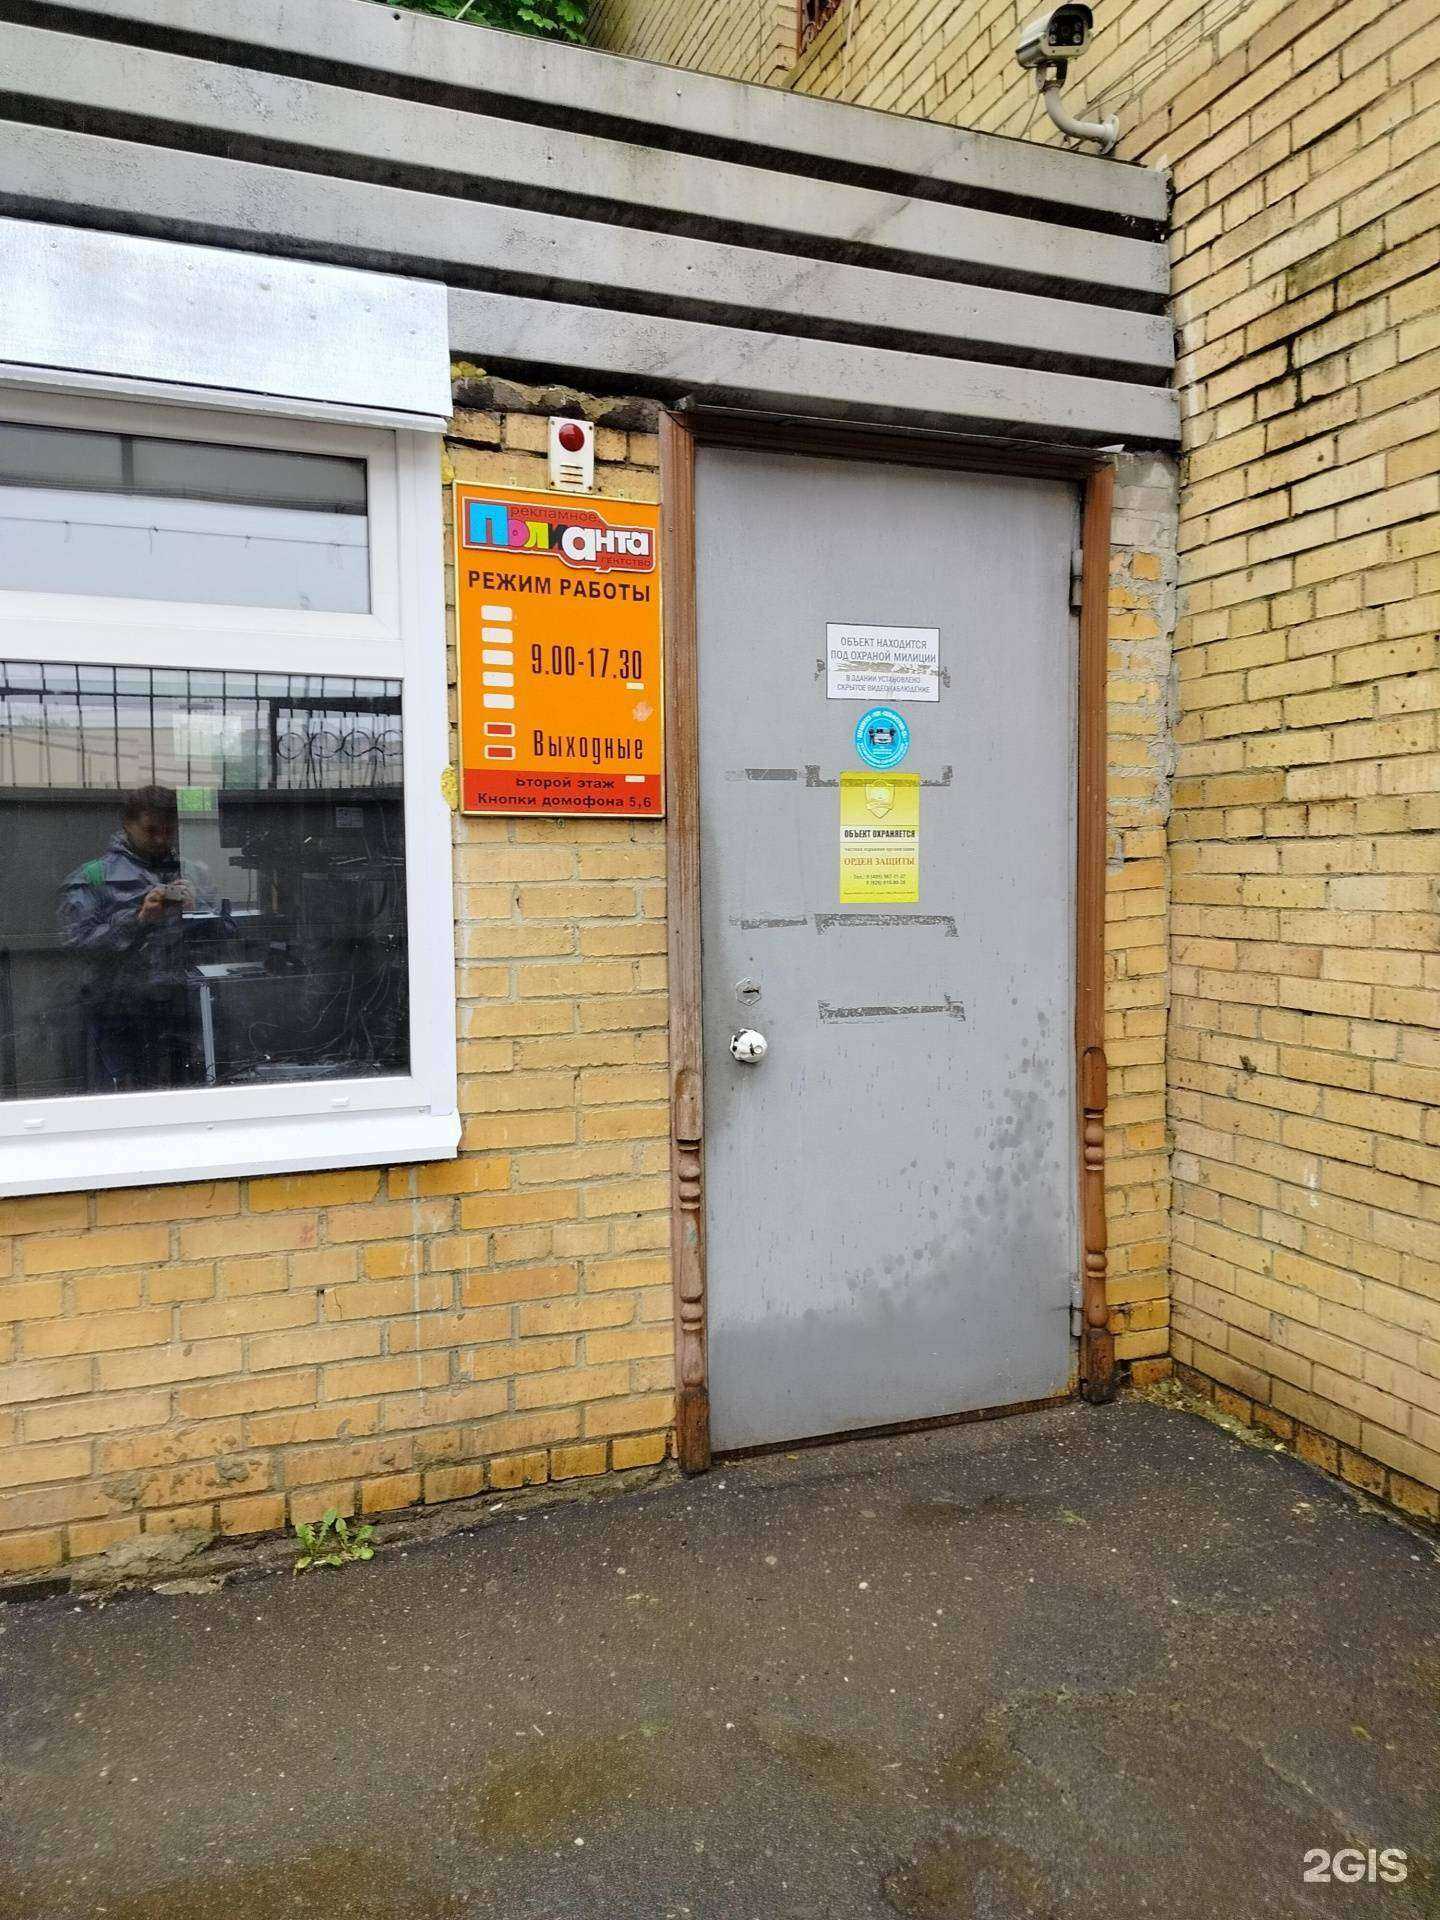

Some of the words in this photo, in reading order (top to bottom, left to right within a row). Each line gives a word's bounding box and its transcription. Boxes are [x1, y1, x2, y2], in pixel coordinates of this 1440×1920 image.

[510, 505, 597, 522] рекламное
[468, 570, 551, 595] РЕЖИМ
[560, 578, 650, 602] РАБОТЫ
[840, 636, 874, 647] ОБЪЕКТ
[876, 638, 927, 649] НАХОДИТСЯ
[531, 643, 642, 680] 9.00-17.30
[831, 649, 848, 661] ПОД
[851, 649, 891, 661] ОХРАНОЙ
[894, 652, 936, 663] МИЛИЦИИ
[533, 729, 643, 765] Выходные
[577, 779, 615, 790] этаж
[478, 792, 536, 806] Кнопки
[542, 795, 624, 808] домофона
[844, 829, 871, 838] ОБЪЕКТ
[872, 829, 916, 838] ОХРАНЯЕТСЯ
[844, 857, 873, 866] ОРДЕН
[875, 857, 915, 866] ЗАЩИТЫ
